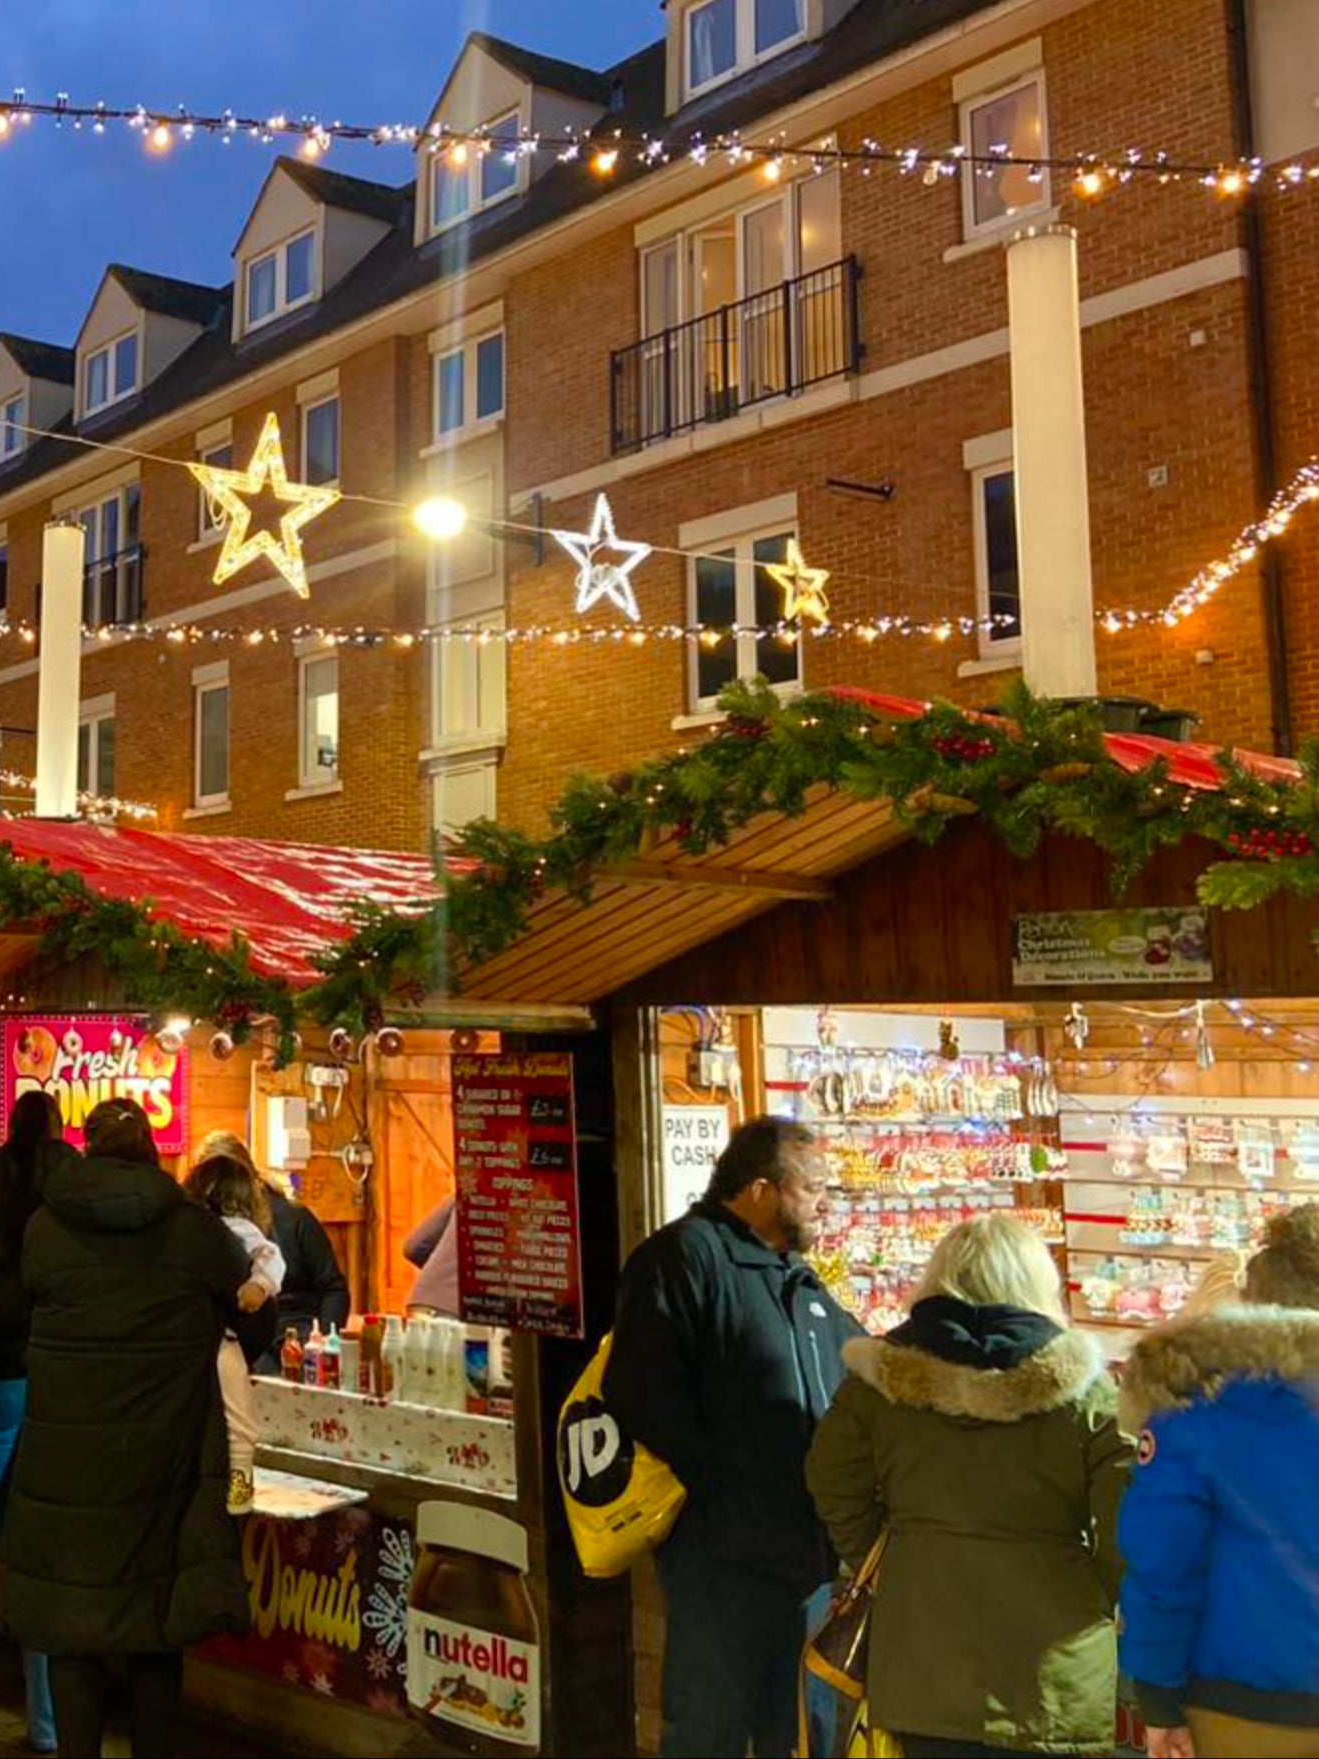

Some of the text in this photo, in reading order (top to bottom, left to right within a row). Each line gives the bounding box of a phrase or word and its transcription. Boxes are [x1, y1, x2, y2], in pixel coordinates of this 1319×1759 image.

[52, 1035, 138, 1083] Fresh
[666, 1118, 721, 1139] PAY BY
[671, 1145, 718, 1167] CASH
[567, 1412, 621, 1493] JD
[242, 1517, 362, 1652] Donuts
[423, 1627, 528, 1683] nutella
